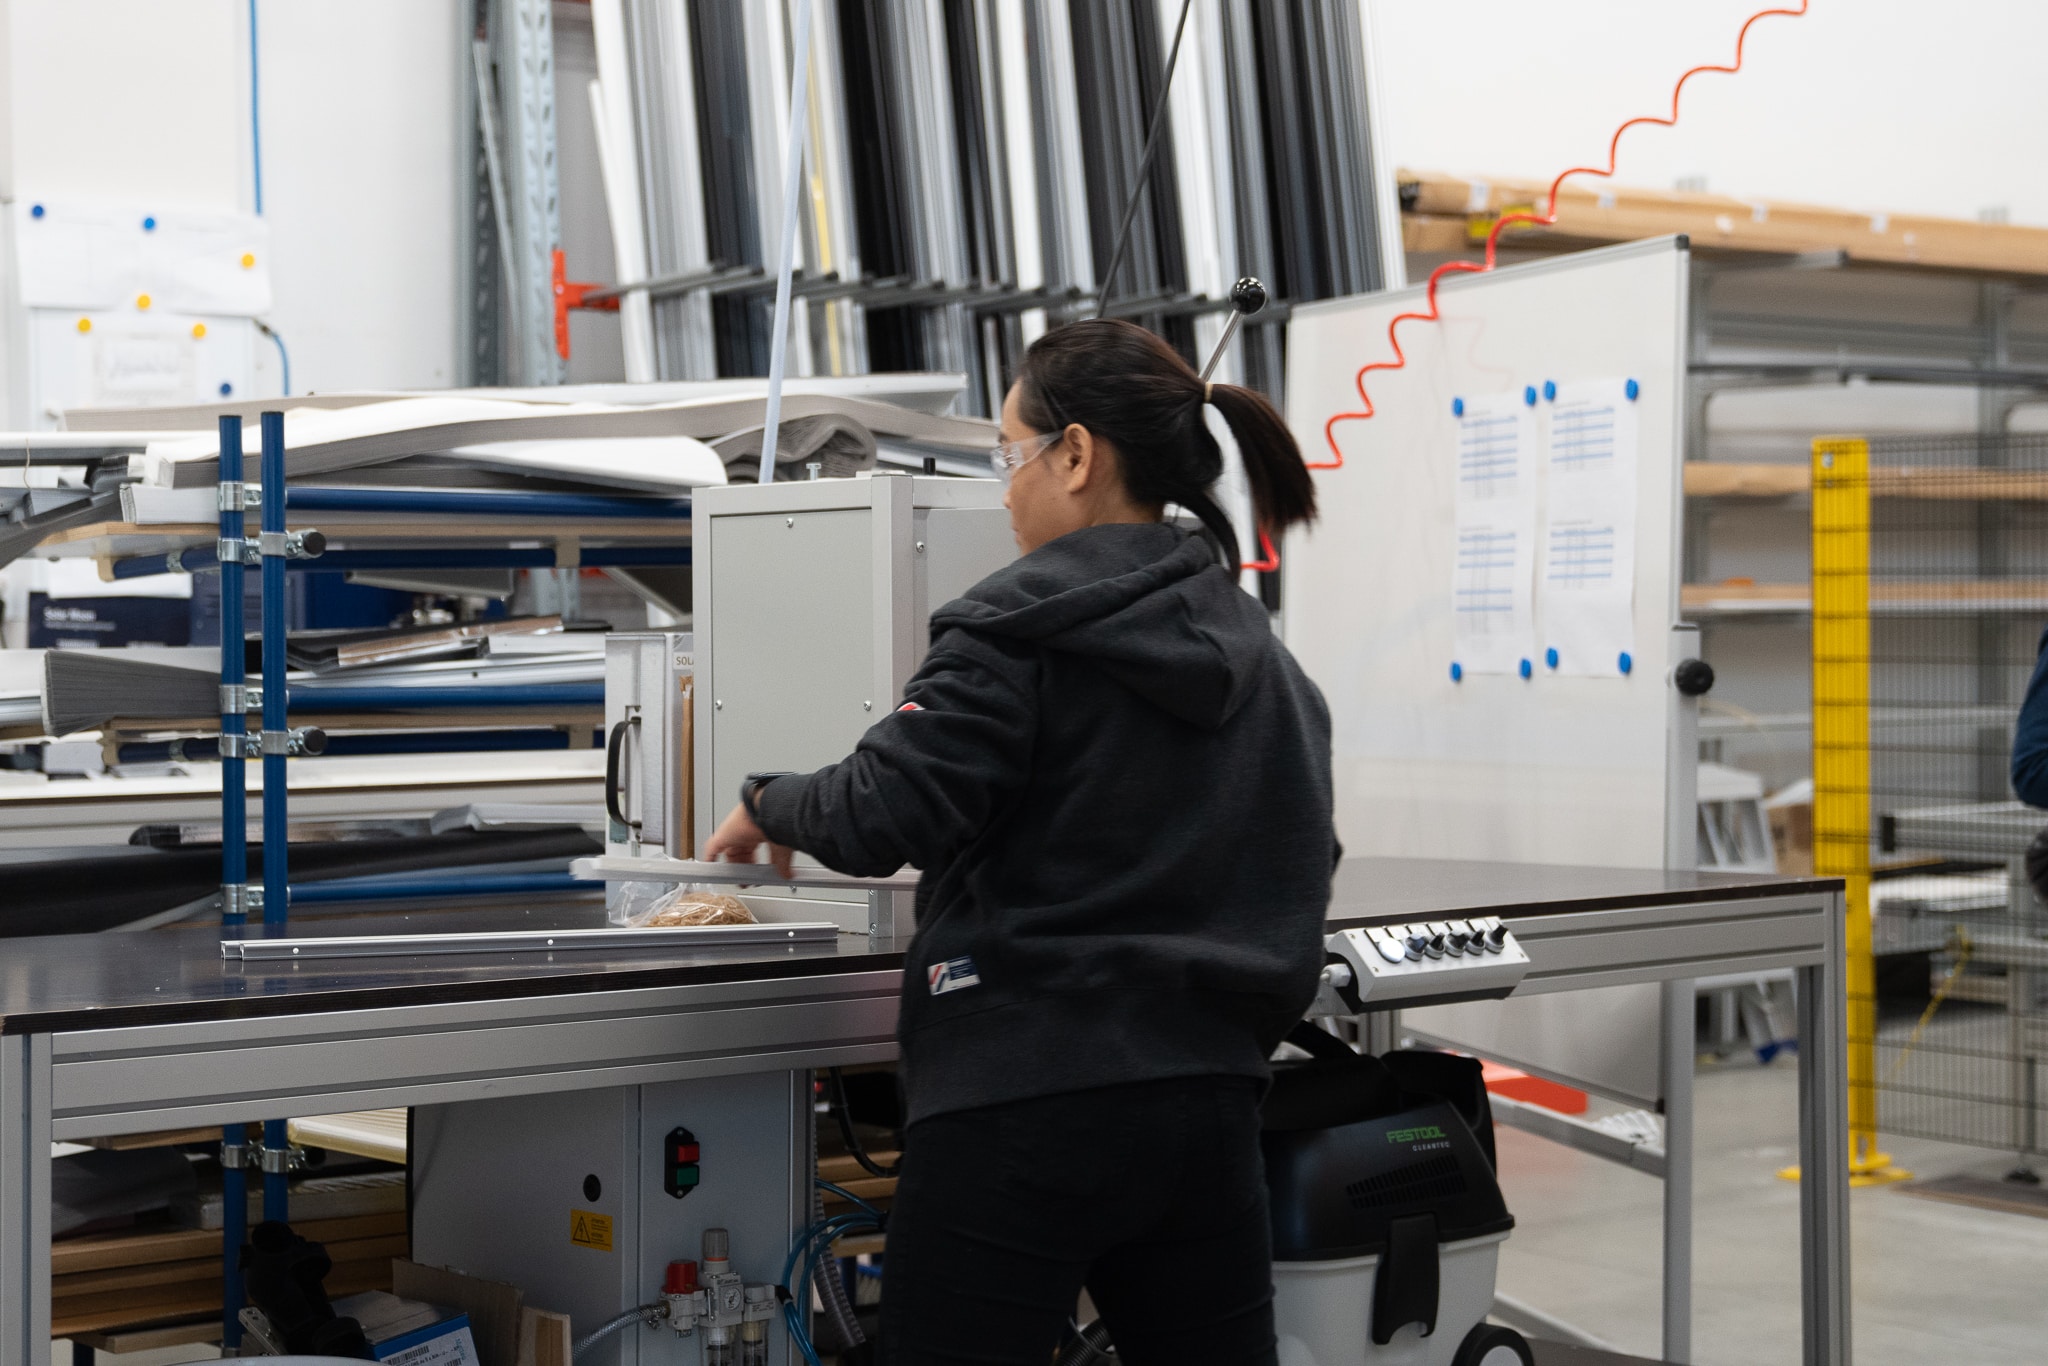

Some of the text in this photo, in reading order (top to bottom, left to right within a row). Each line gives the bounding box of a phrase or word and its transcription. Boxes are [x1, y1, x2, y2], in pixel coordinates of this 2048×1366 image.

[676, 656, 694, 666] SOL
[1386, 1126, 1447, 1143] FESTOOL
[1412, 1141, 1451, 1152] CLEANTEC
